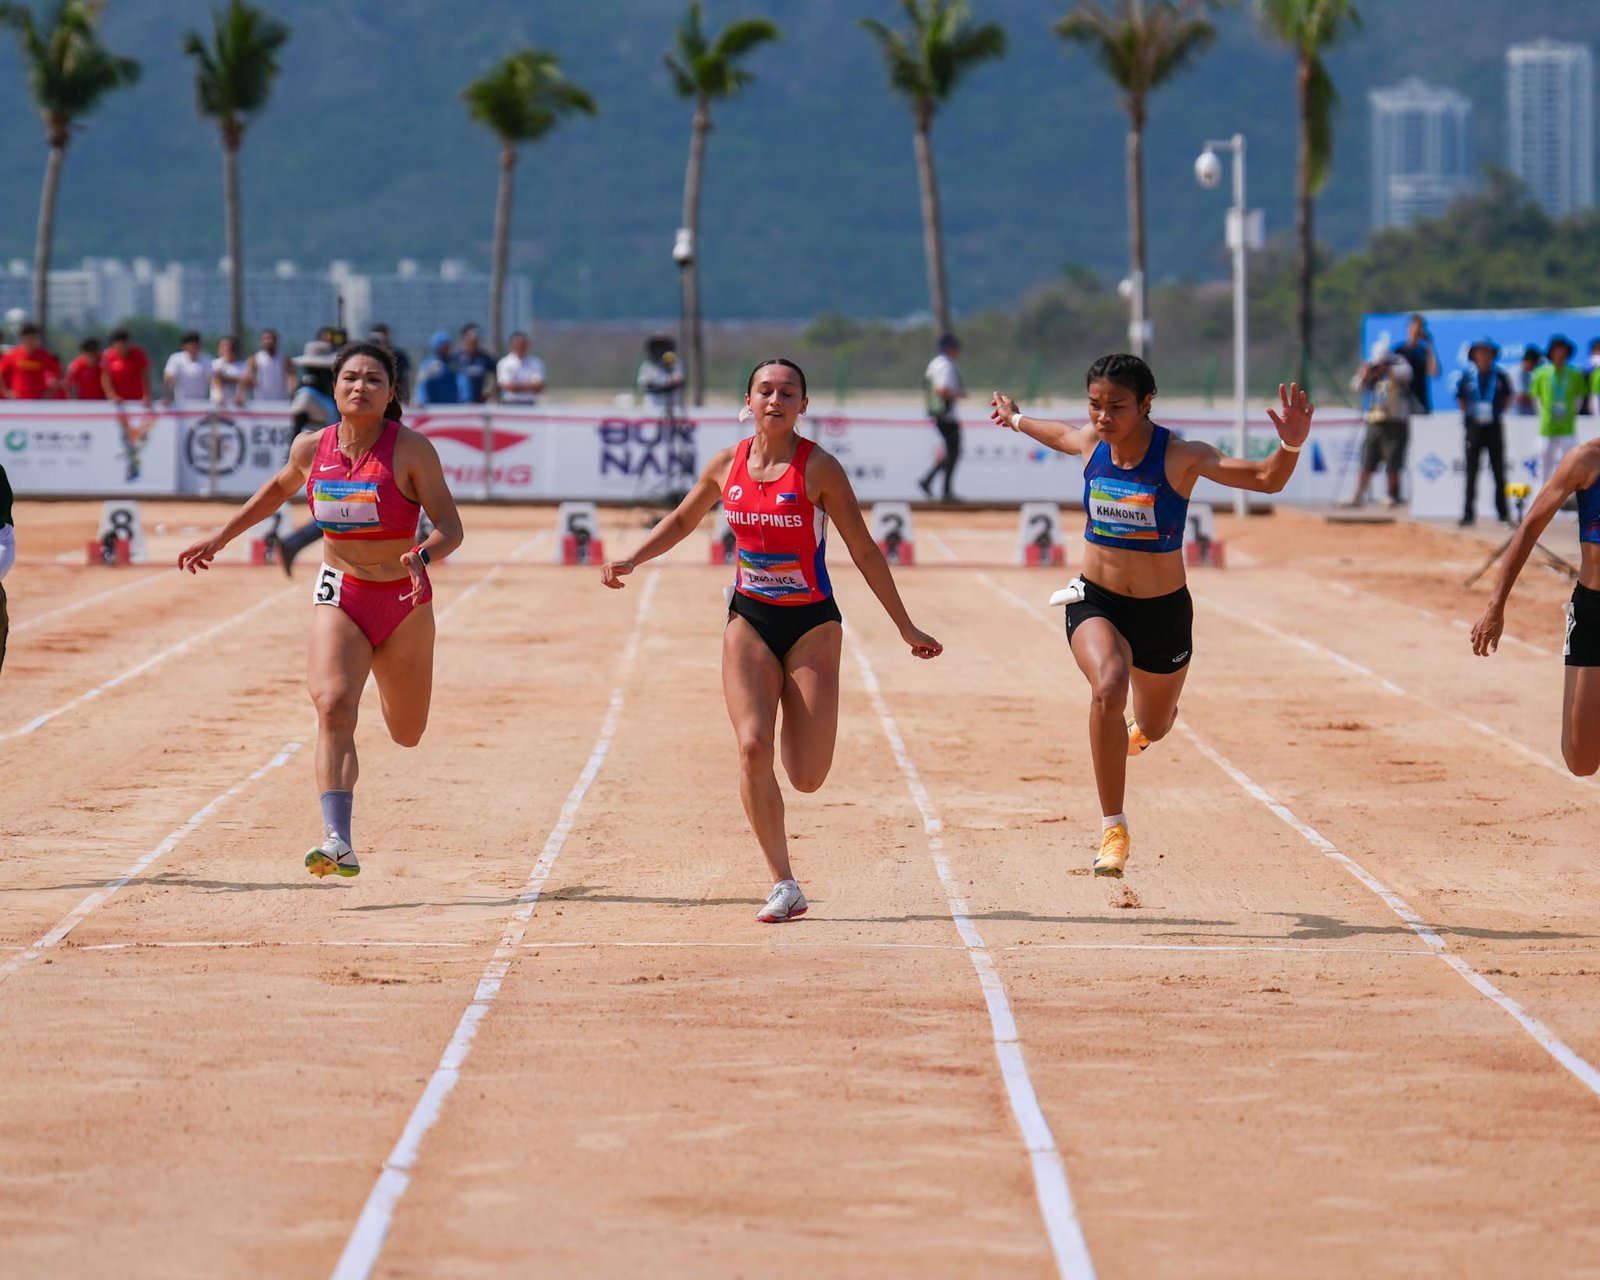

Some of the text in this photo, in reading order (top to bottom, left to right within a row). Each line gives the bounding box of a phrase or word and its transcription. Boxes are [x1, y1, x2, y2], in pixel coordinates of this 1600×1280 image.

[340, 507, 349, 517] LI
[724, 510, 803, 528] PHILIPPINES
[1096, 505, 1147, 521] KHANONTA
[110, 508, 133, 540] 8
[316, 569, 336, 602] 5
